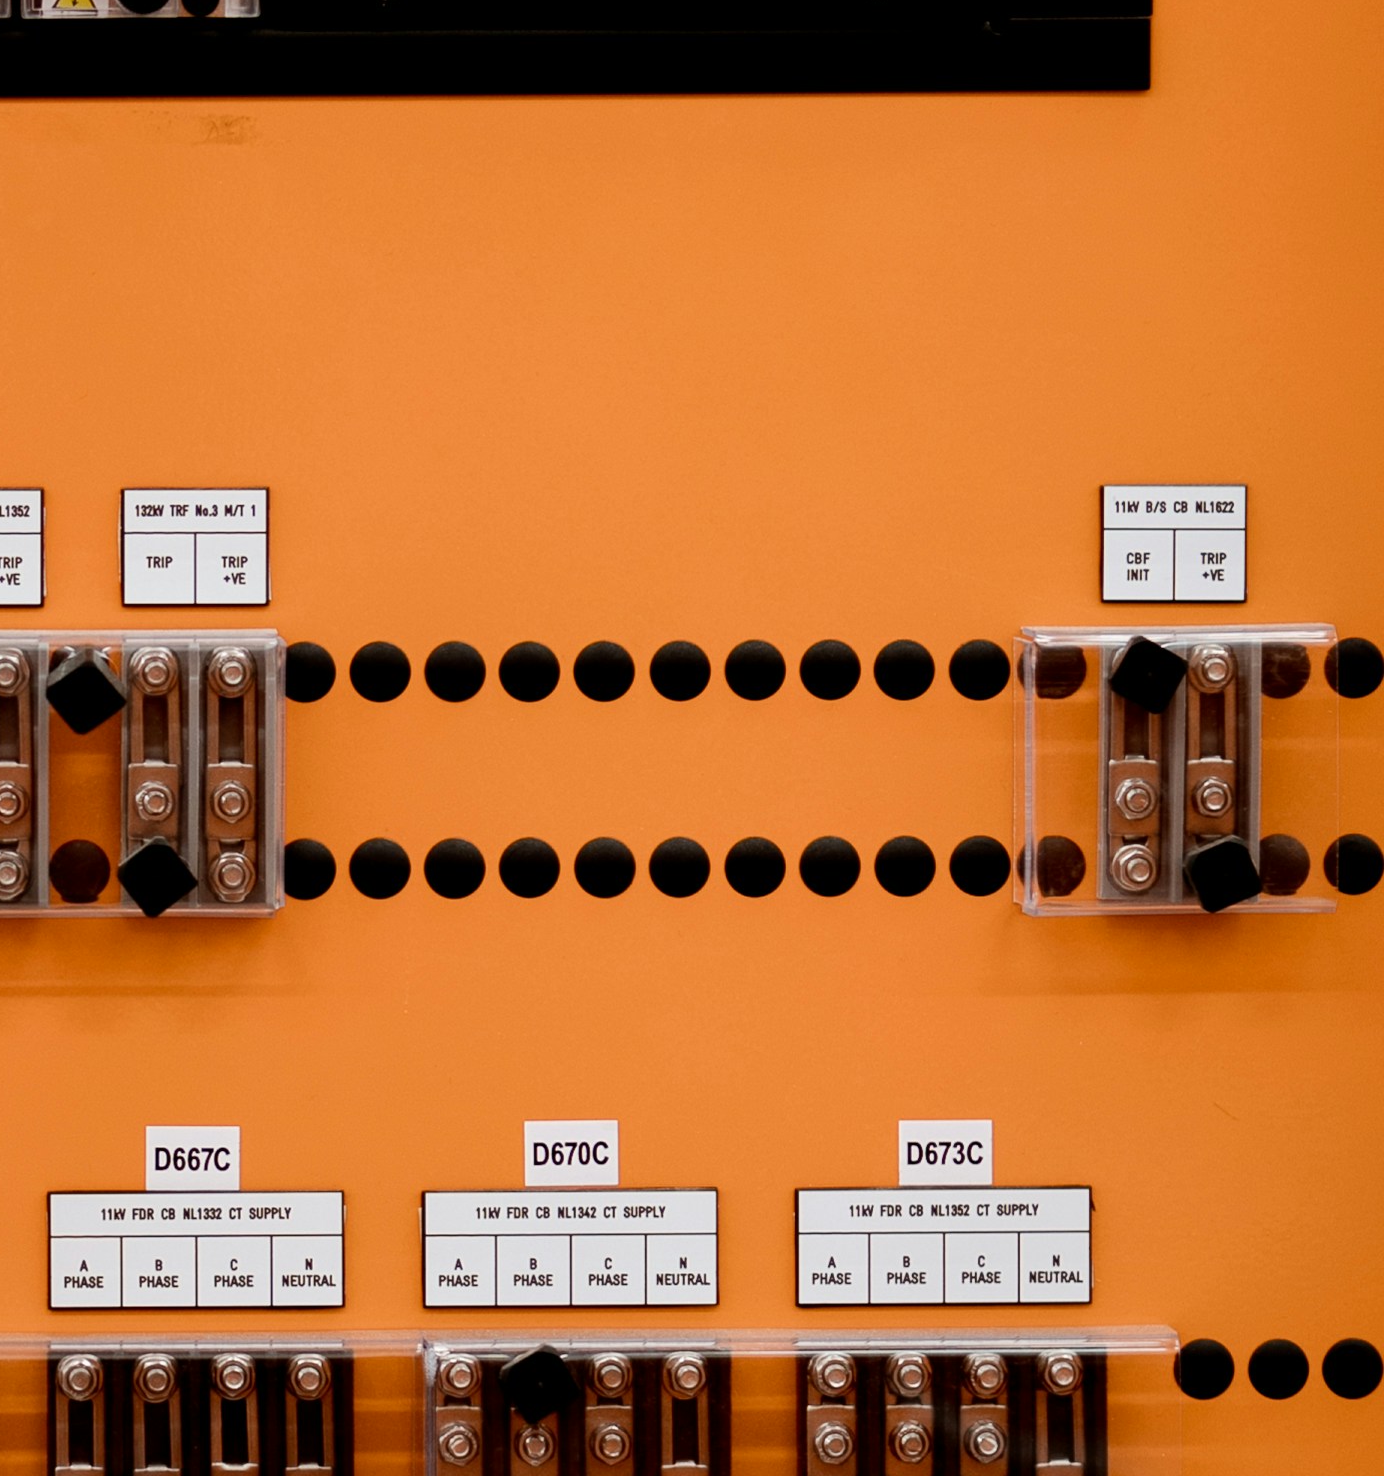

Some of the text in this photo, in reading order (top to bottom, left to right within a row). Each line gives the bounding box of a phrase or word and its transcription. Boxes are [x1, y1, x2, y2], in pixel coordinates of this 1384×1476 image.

[135, 504, 256, 518] 132kV TRF No.3 M/T 1
[1115, 500, 1235, 514] 11kV B/S CB NL1622
[145, 555, 174, 569] TRIP
[221, 555, 249, 569] TRIP
[1126, 551, 1151, 565] CBF
[1200, 552, 1227, 565] TRIP
[223, 572, 246, 585] +VE
[1126, 568, 1150, 581] INIT
[1202, 568, 1225, 582] +VE
[154, 1147, 231, 1172] D667C
[533, 1140, 609, 1166] D670C
[907, 1140, 984, 1166] D673C
